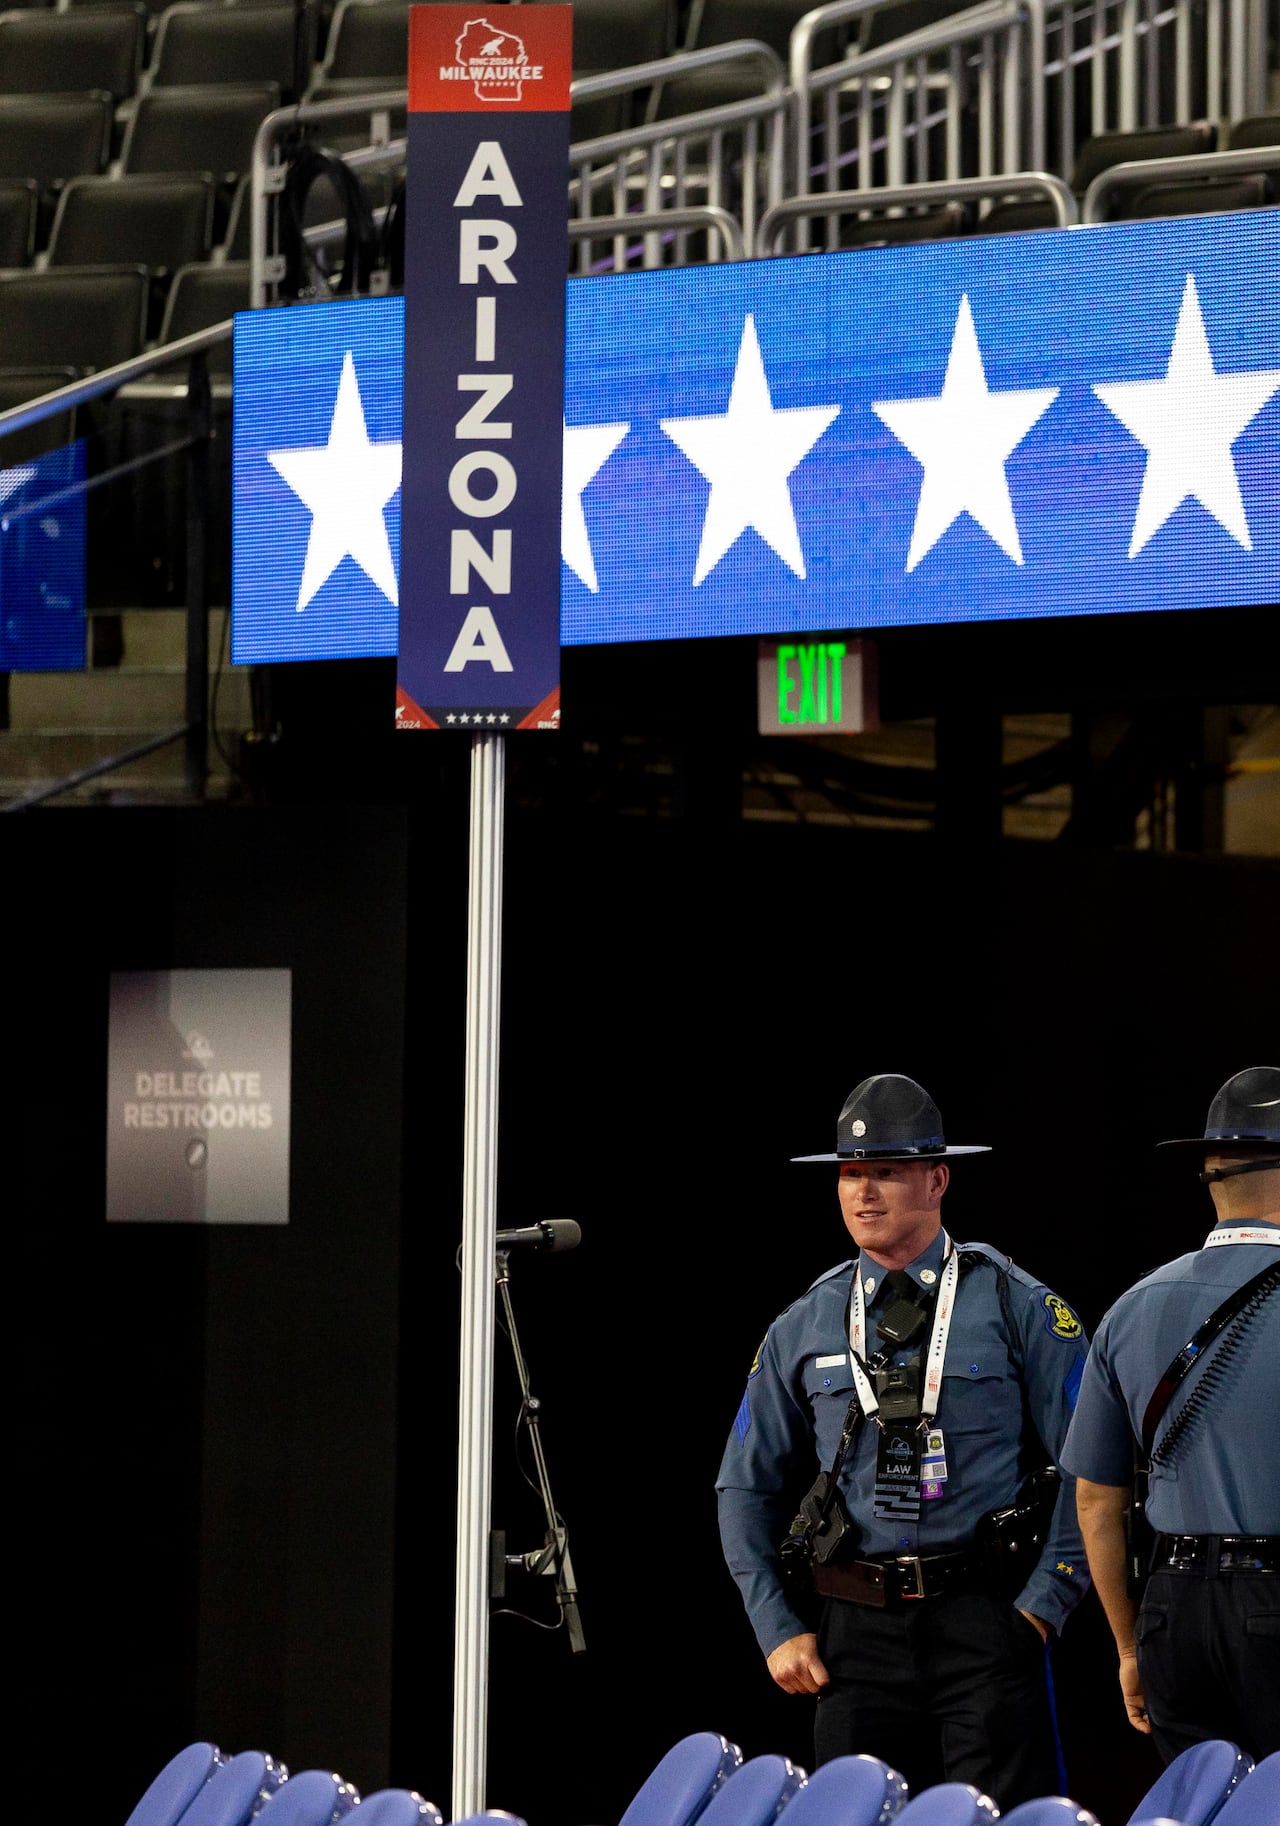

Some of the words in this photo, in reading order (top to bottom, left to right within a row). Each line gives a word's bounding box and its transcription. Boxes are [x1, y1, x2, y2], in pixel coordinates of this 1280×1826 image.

[439, 66, 543, 80] MILWAUKEE
[443, 141, 523, 673] ARIZONA
[777, 642, 847, 724] EXIT
[537, 720, 559, 730] RNC
[136, 1072, 261, 1097] DELEGATE
[124, 1103, 273, 1129] RESTROOMS
[878, 1472, 919, 1481] ENFORCEMENT
[886, 1464, 912, 1474] LAW
